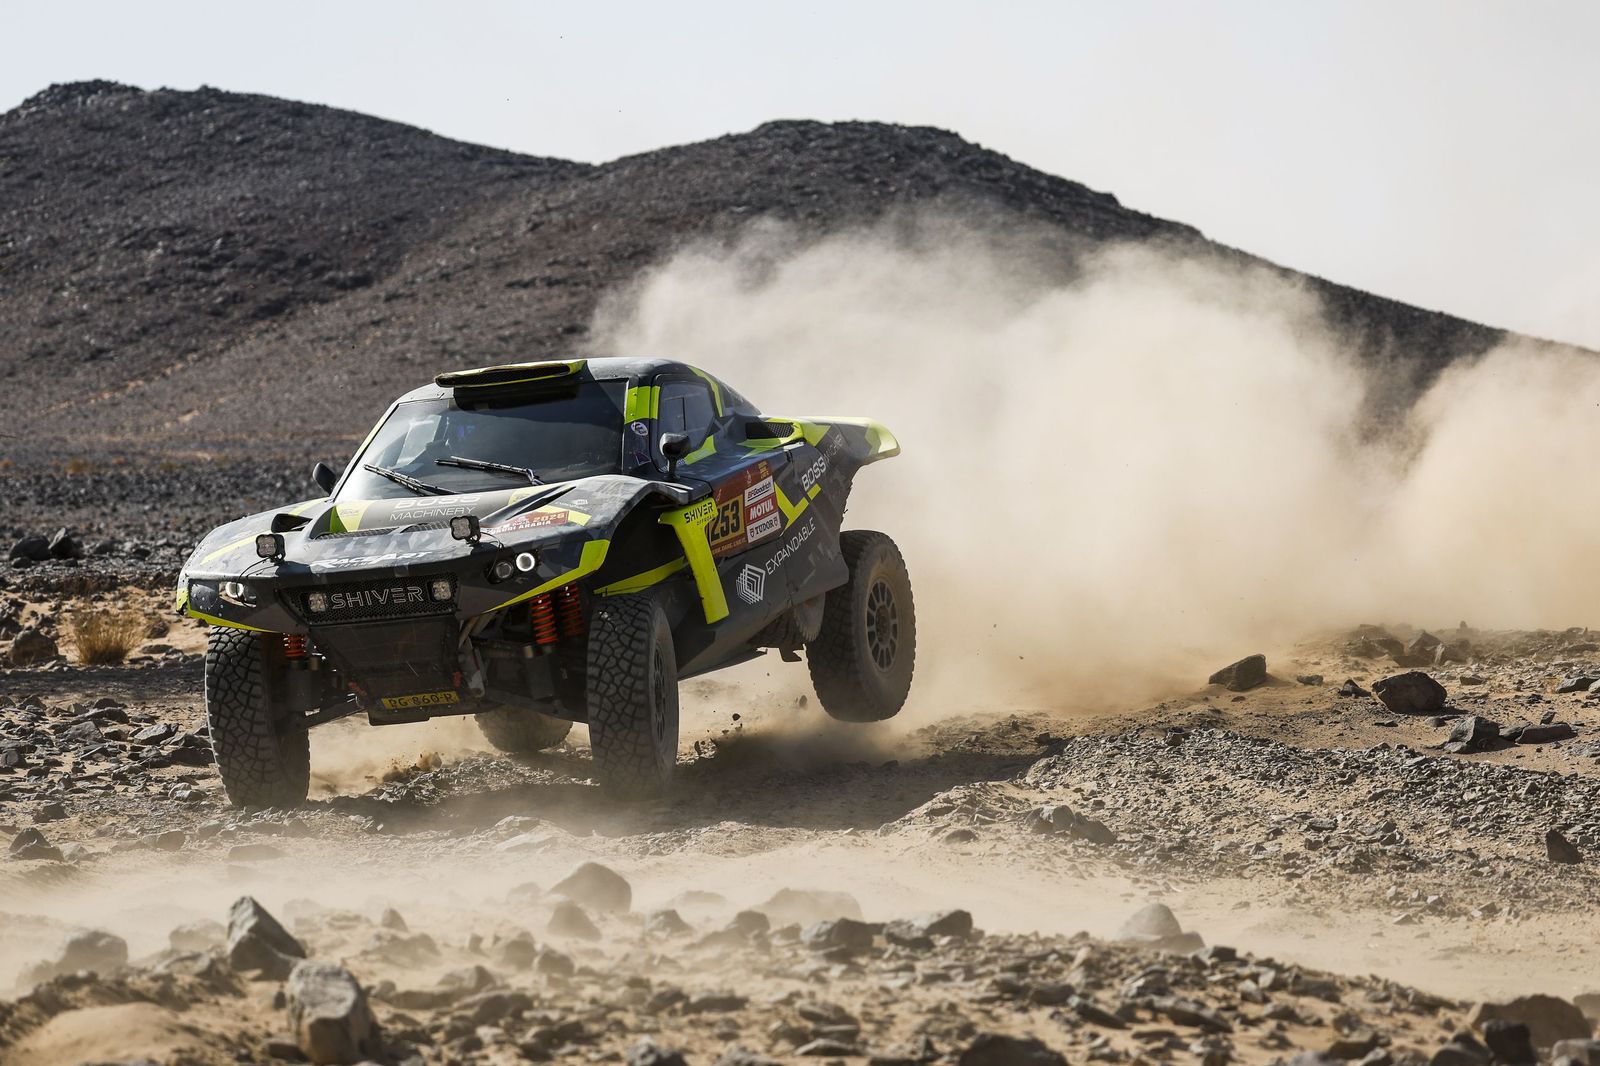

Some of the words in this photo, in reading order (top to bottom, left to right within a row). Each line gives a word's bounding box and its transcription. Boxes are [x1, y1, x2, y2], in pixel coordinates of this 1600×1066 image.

[801, 456, 826, 491] BOSS
[394, 494, 481, 508] BOSS
[747, 482, 771, 499] BFGoodrich
[390, 506, 476, 521] MACHINERY
[684, 502, 713, 523] SHIVER
[750, 498, 774, 520] MOTUL
[710, 499, 740, 541] 253
[754, 519, 774, 534] TUDOR
[765, 517, 816, 575] EXPANDABLE
[331, 586, 424, 609] SHIVER
